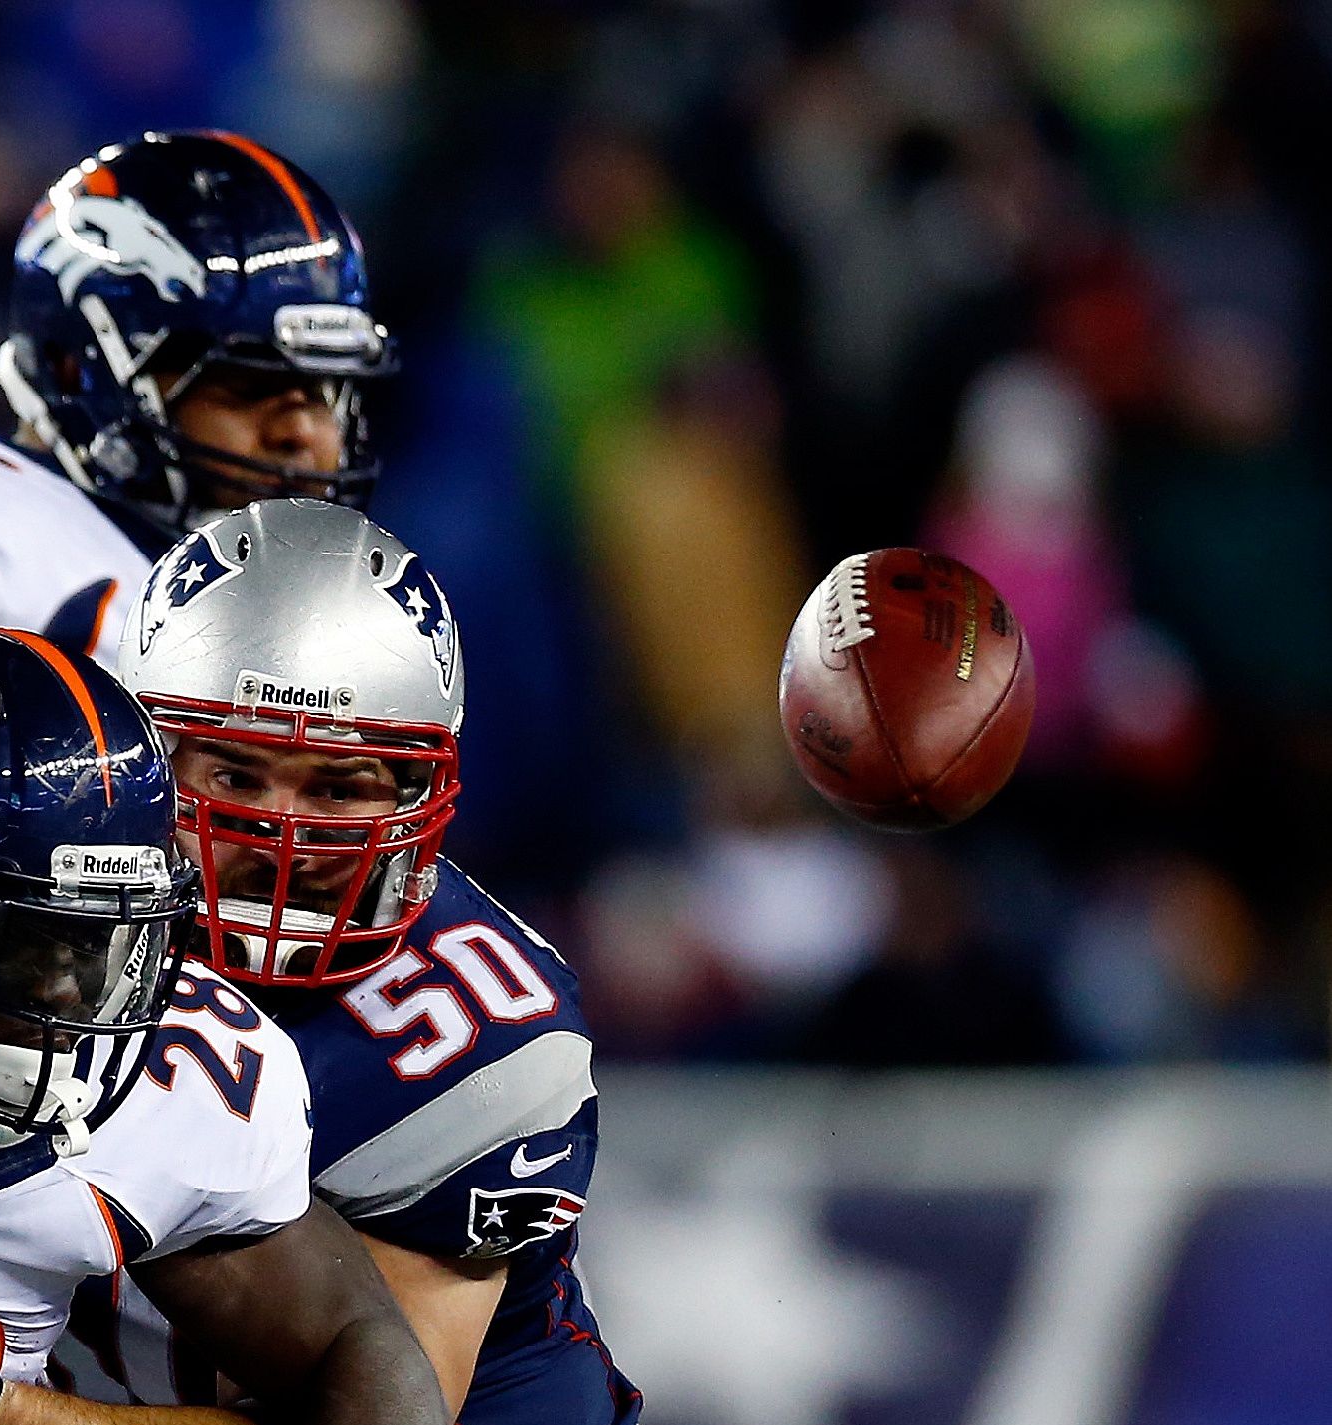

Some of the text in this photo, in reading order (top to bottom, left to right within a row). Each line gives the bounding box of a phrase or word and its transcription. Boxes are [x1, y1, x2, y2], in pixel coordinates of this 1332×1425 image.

[261, 683, 330, 709] Riddell
[84, 855, 138, 874] Riddell
[343, 920, 558, 1082] 50
[143, 972, 264, 1122] 28
